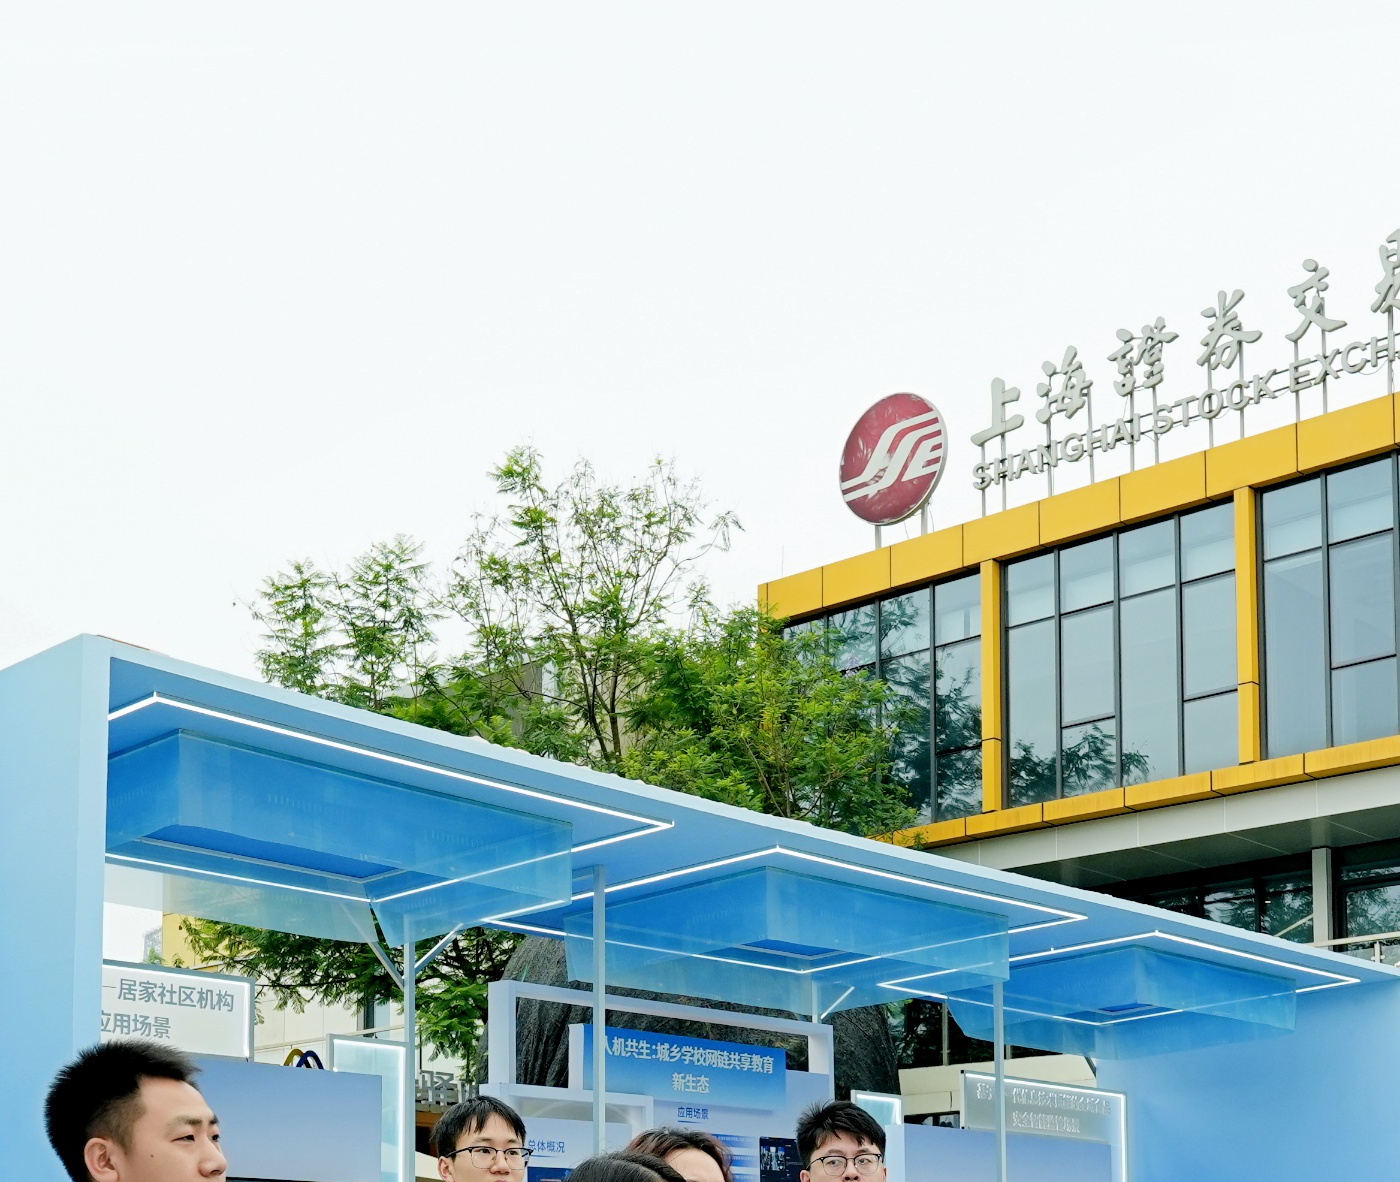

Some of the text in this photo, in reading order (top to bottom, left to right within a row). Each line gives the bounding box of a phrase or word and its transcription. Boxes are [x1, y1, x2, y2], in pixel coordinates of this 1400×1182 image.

[972, 413, 1141, 490] SHANGHAI
[1152, 368, 1278, 436] STOCK
[671, 1072, 710, 1094] 新生态
[677, 1107, 709, 1120] 应用场景
[528, 1139, 566, 1154] 总体概况
